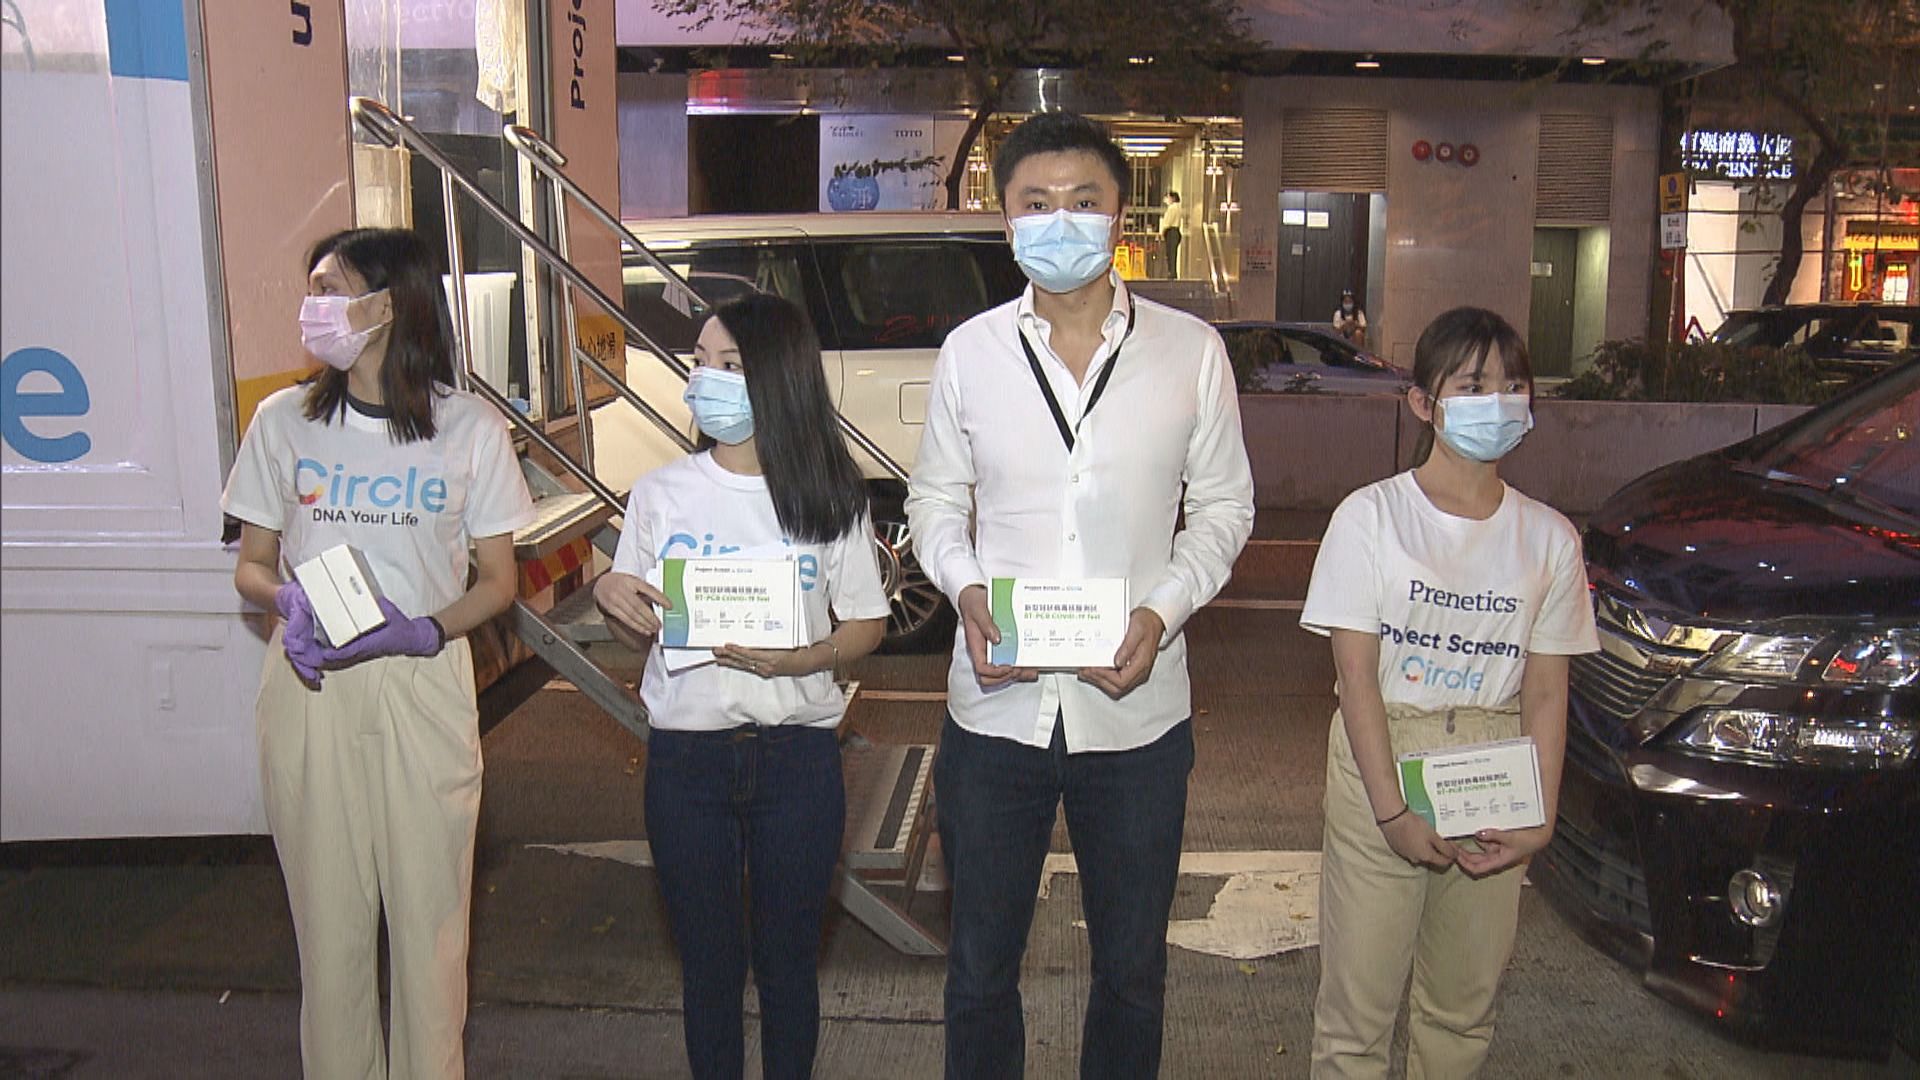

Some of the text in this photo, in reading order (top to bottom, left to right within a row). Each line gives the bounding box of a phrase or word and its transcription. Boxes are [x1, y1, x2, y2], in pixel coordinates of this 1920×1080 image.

[296, 458, 447, 513] Circle
[313, 508, 419, 527] DNA Your Life
[1447, 634, 1520, 659] Screen
